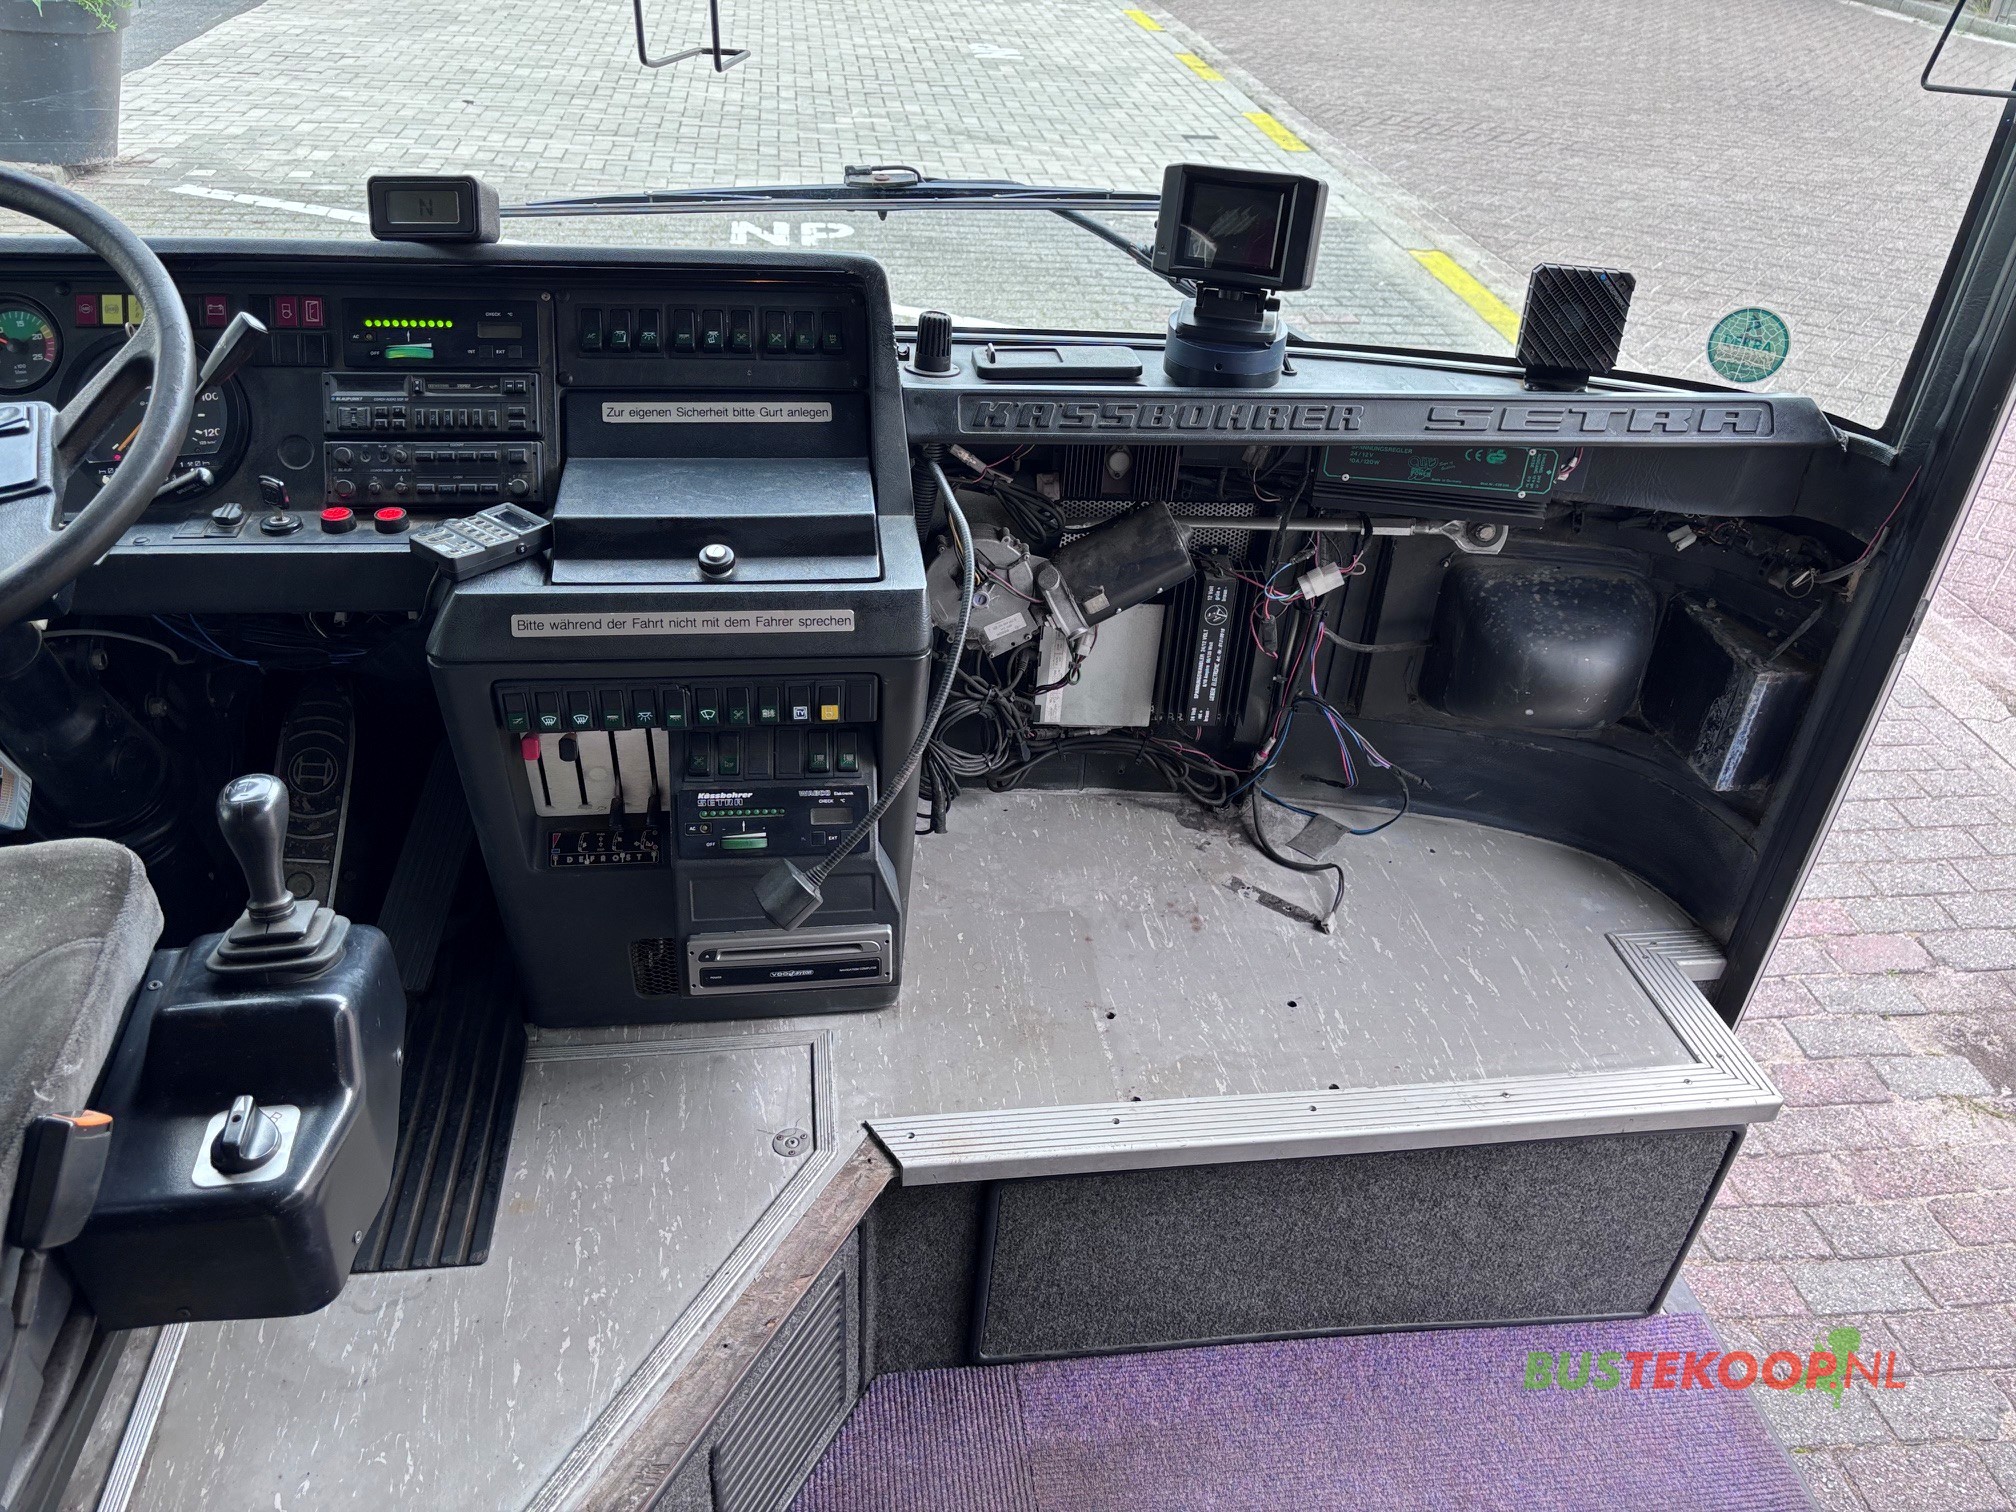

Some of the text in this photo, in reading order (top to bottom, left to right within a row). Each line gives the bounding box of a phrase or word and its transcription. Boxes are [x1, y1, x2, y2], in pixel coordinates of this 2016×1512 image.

[418, 197, 433, 217] N
[729, 221, 855, 246] NP
[606, 406, 829, 419] Zur eigenen Sicherheit bitte Gurt anlegen
[1424, 406, 1765, 433] SETRA
[517, 615, 852, 631] Bitte während der Fahrt nicht mit dem Fahrer sprechen
